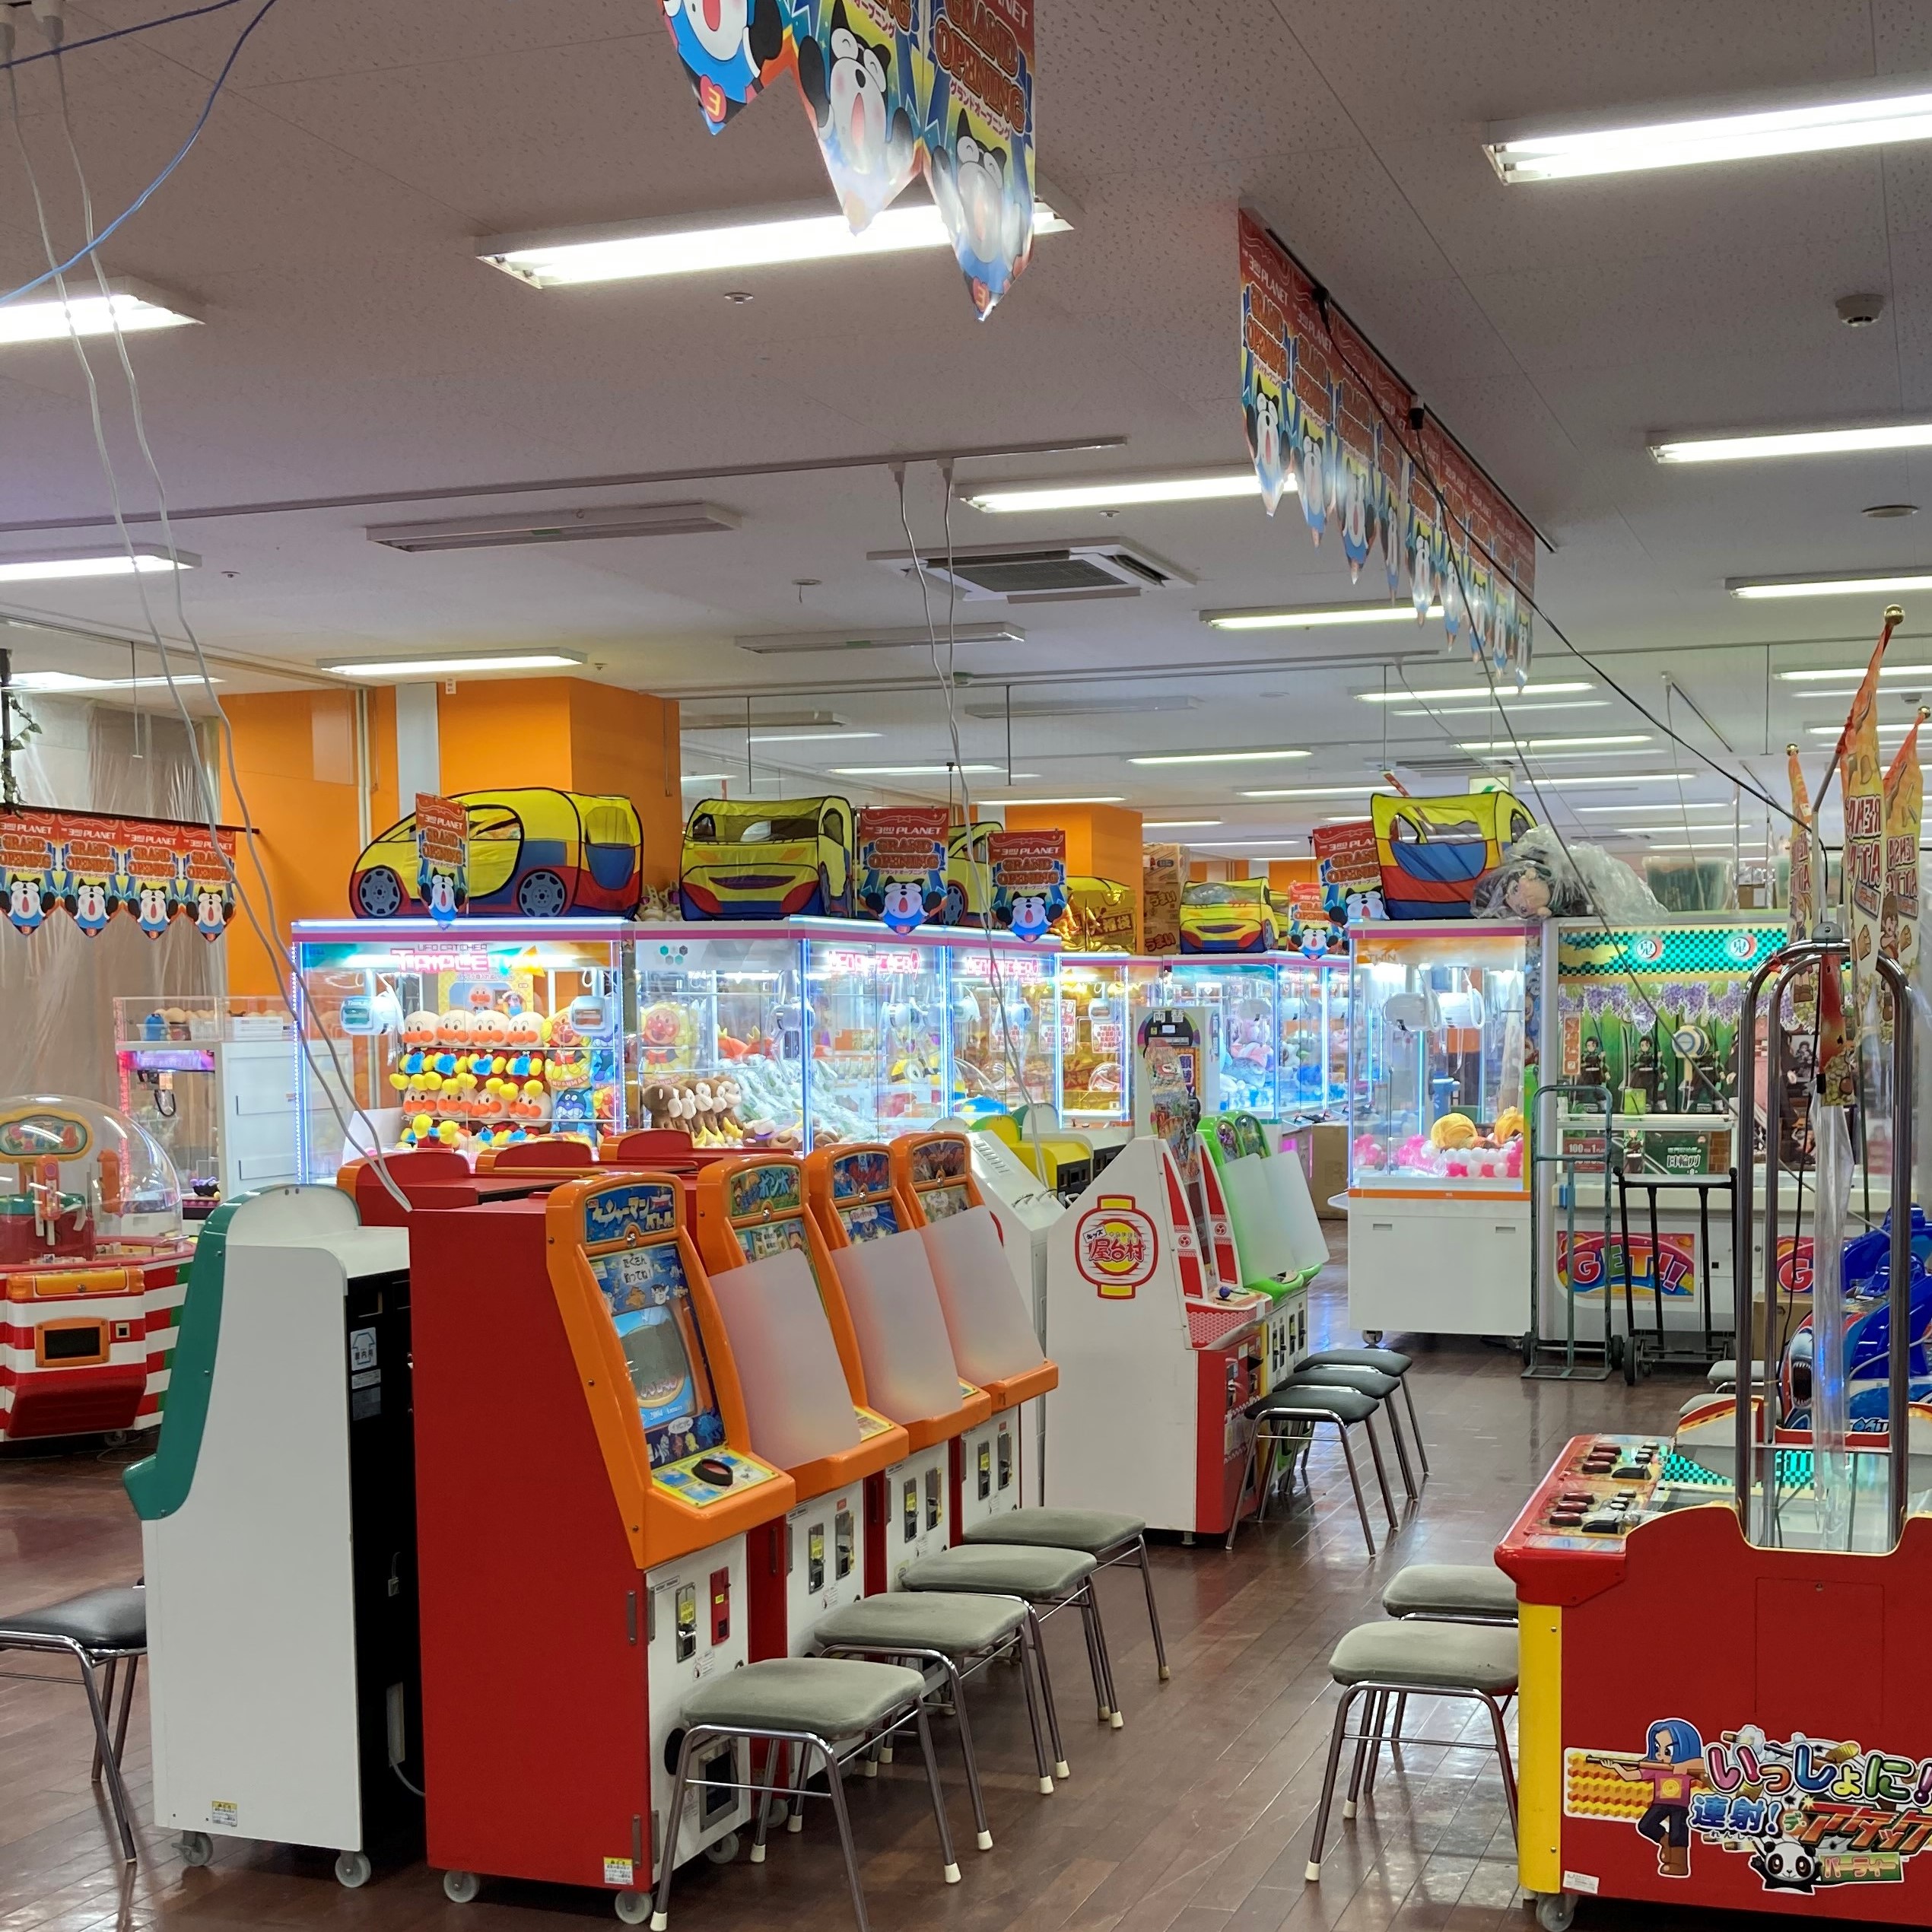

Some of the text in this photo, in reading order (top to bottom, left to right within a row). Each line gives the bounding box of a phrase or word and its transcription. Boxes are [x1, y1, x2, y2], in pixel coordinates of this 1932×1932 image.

[935, 17, 1025, 133] OPENING
[951, 79, 1010, 140] グランドオープニング
[1261, 270, 1289, 305] PLANET
[1308, 320, 1332, 354] PLANET
[17, 824, 52, 834] PLANET
[437, 818, 462, 830] PLANET
[895, 827, 942, 835] PLANET
[83, 831, 116, 840] PLANET
[145, 836, 176, 846] PLANET
[1150, 891, 1177, 907] うまい
[1145, 932, 1177, 952] うまい
[1637, 939, 1657, 958] 鬼
[1730, 936, 1749, 956] 鬼
[1368, 953, 1397, 962] TWIN
[1152, 1009, 1184, 1023] 両替
[1569, 1144, 1584, 1153] 100
[1086, 1229, 1104, 1240] キッズ
[1088, 1237, 1146, 1263] 屋台村
[1572, 1245, 1689, 1292] GET!!
[1708, 1744, 1932, 1804] いっしょに!
[1691, 1795, 1782, 1833] 連射!
[1800, 1801, 1932, 1853] アタック
[1825, 1857, 1897, 1879] パーティー
